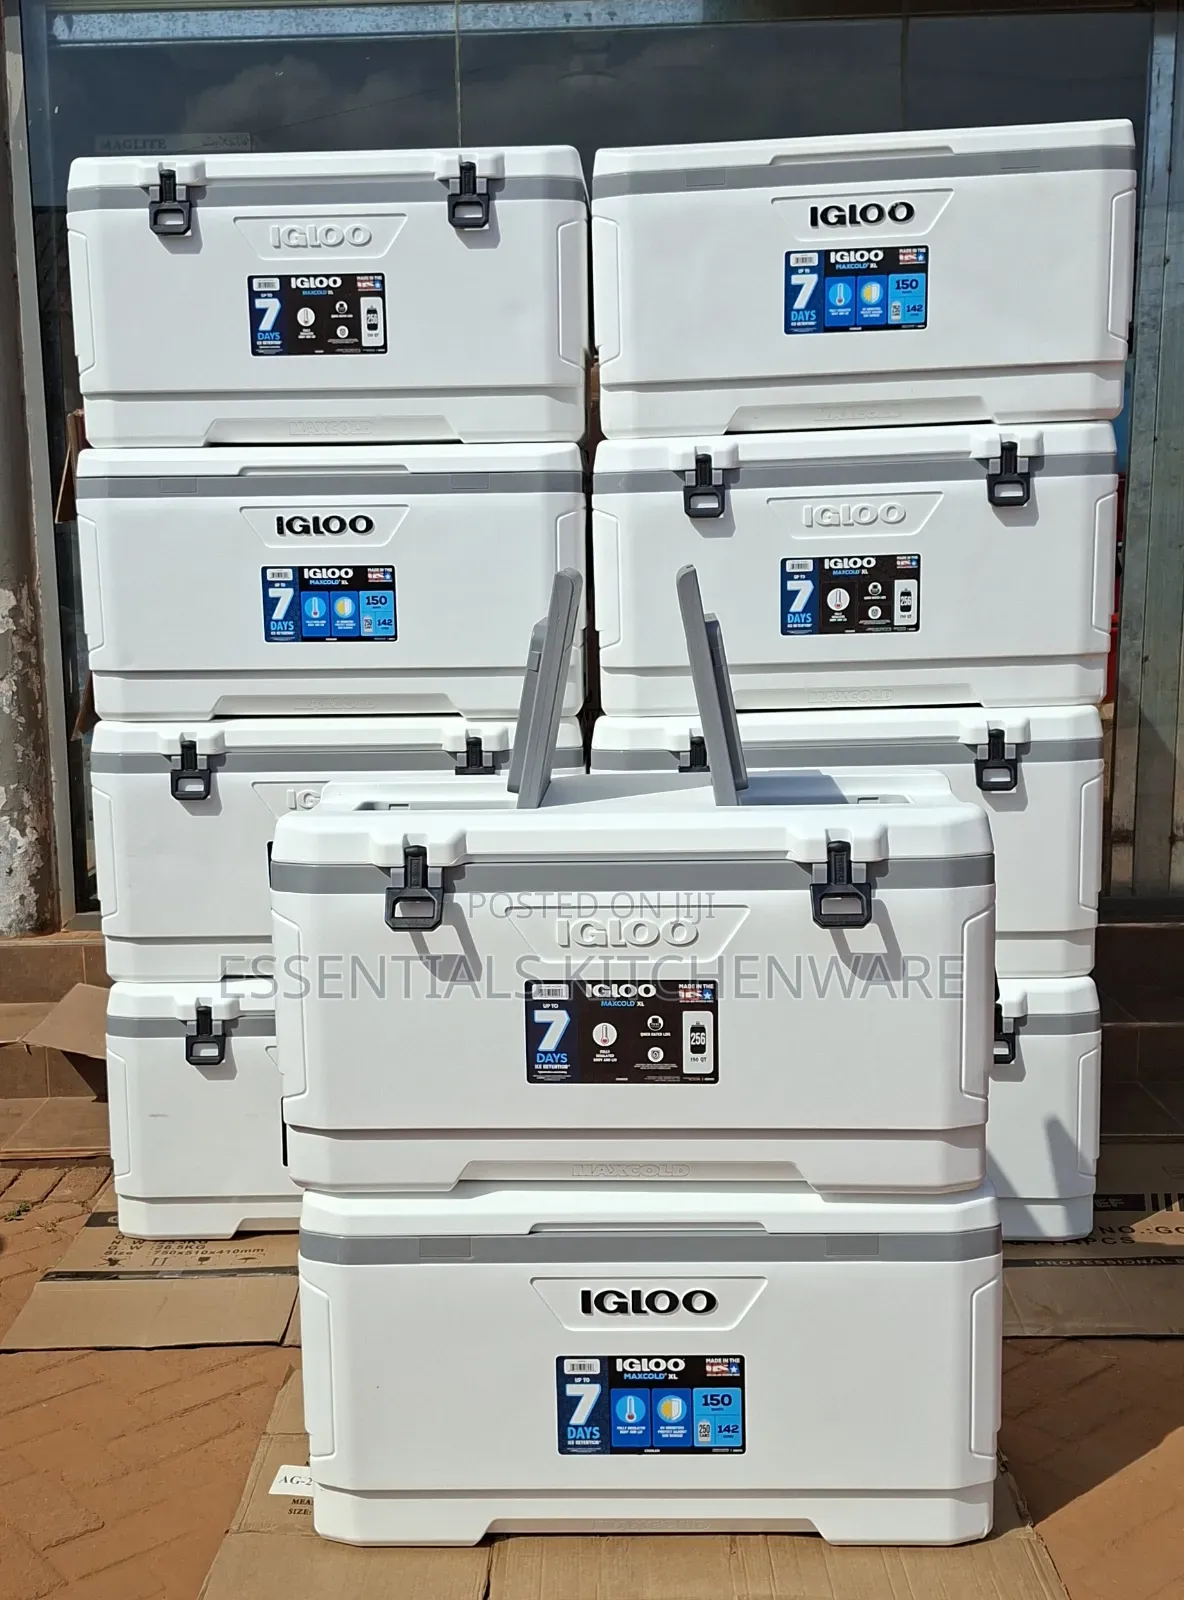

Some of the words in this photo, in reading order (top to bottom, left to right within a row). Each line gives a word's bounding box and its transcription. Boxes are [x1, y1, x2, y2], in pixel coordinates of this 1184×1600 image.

[810, 202, 914, 228] IGLOO
[270, 224, 372, 248] IGLOO
[830, 250, 883, 263] IGLOO
[290, 277, 342, 288] IGLOO
[895, 279, 918, 290] 150
[791, 274, 818, 310] 7
[255, 298, 281, 331] 7
[791, 310, 816, 321] DAYS
[803, 502, 906, 528] IGLOO
[276, 515, 375, 536] IGLOO
[824, 557, 876, 569] IGLOO
[304, 568, 353, 579] IGLOO
[366, 596, 388, 605] 150
[787, 580, 814, 612] 7
[900, 596, 912, 606] 256
[268, 588, 294, 620] 7
[788, 613, 812, 623] DAYS
[270, 621, 294, 630] DAYS
[557, 920, 699, 948] IGLOO
[586, 984, 656, 997] IGLOO
[534, 1010, 571, 1051] 7
[690, 1032, 706, 1045] 256
[536, 1053, 568, 1063] DAYS
[572, 1164, 690, 1177] MAXCOLD
[1035, 1258, 1171, 1266] PROFESSIONAL
[581, 1290, 718, 1315] IGLOO
[616, 1359, 685, 1372] IGLOO
[566, 1384, 601, 1425] 7
[702, 1394, 732, 1406] 150
[567, 1427, 600, 1439] DAYS
[699, 1425, 710, 1433] 250
[718, 1425, 739, 1433] 142
[278, 1475, 313, 1486] AG-2
